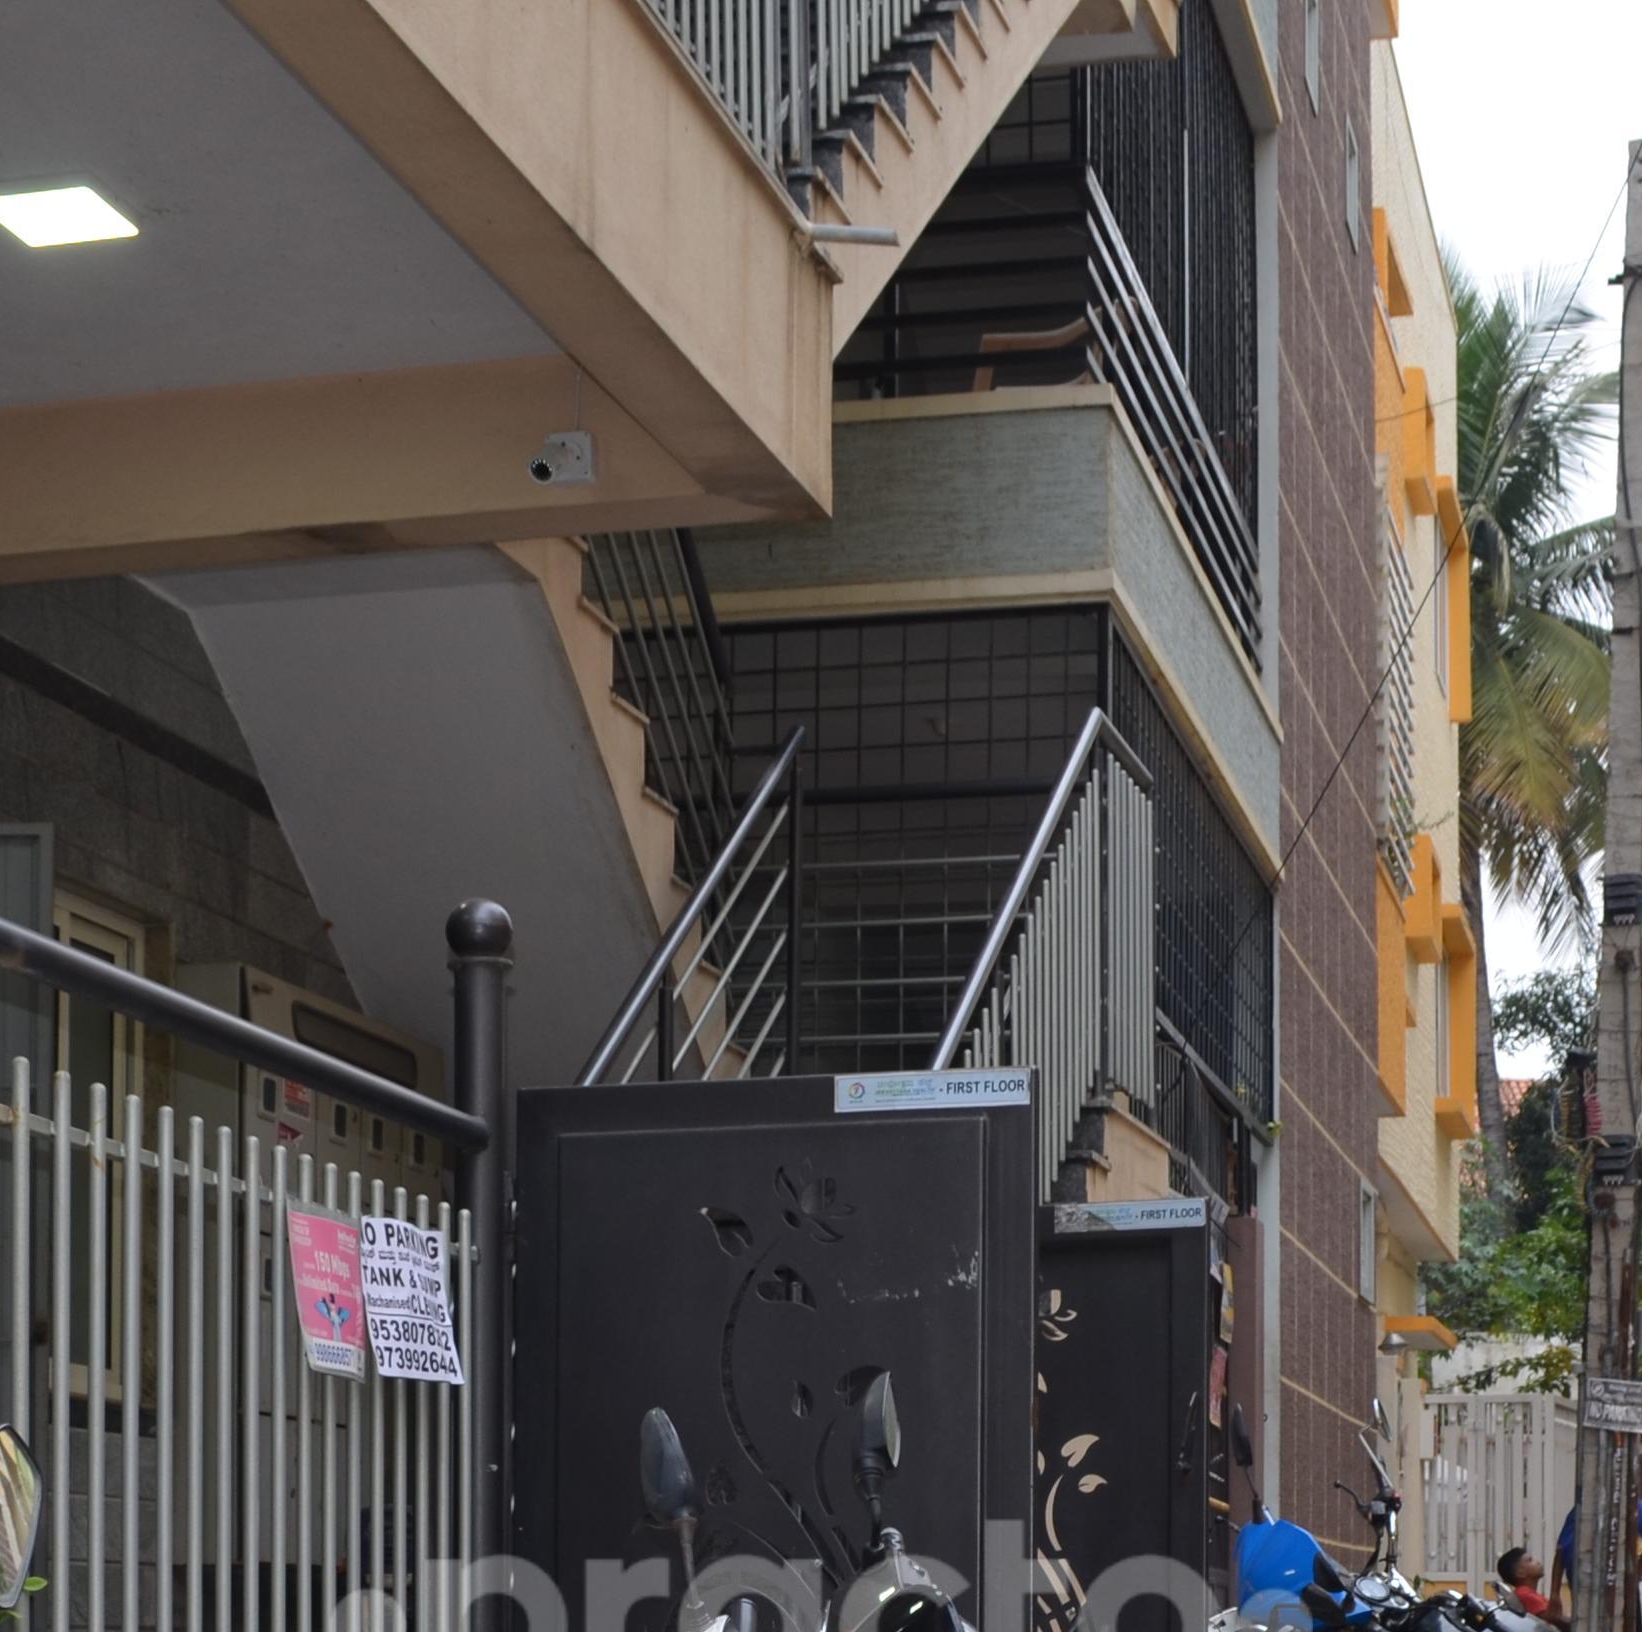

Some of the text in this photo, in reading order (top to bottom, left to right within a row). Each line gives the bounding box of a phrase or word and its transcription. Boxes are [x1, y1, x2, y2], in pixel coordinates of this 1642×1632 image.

[946, 1081, 981, 1095] FIRST
[984, 1079, 1025, 1093] FLOOR
[1140, 1210, 1166, 1220] FIRST
[1169, 1207, 1202, 1218] FLOOR
[362, 1264, 406, 1288] TANK
[409, 1269, 418, 1290] &
